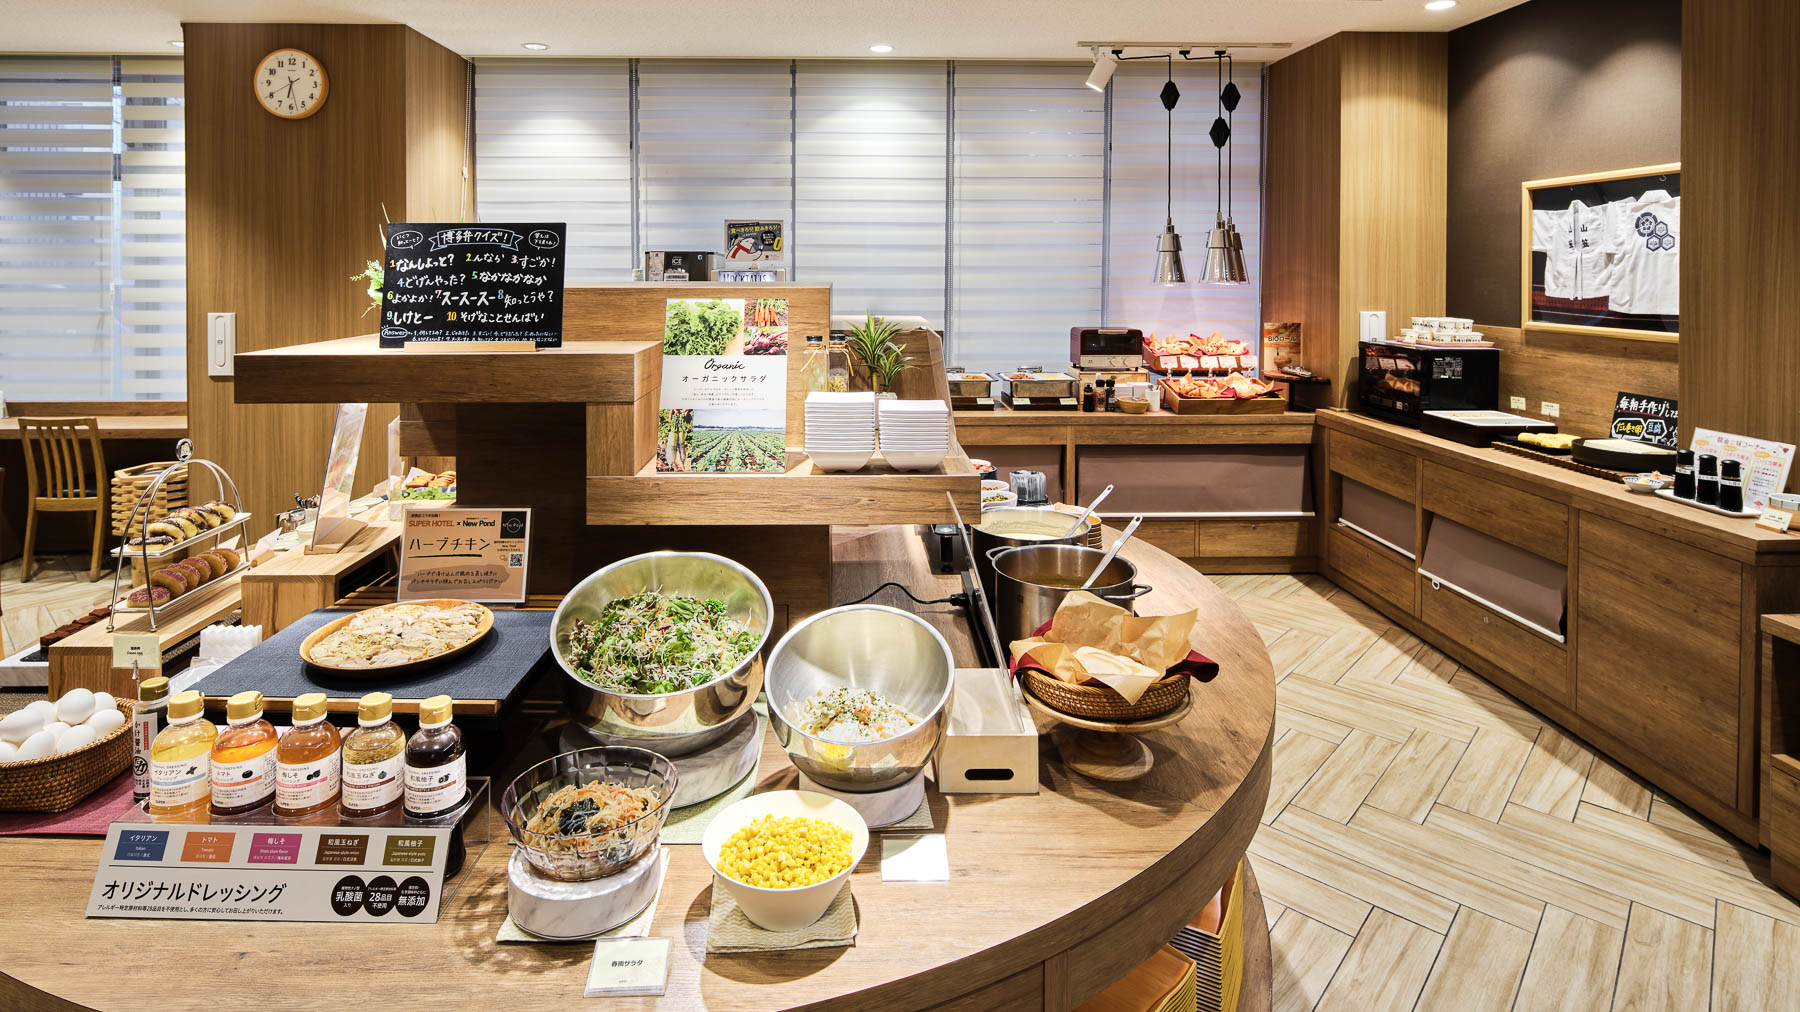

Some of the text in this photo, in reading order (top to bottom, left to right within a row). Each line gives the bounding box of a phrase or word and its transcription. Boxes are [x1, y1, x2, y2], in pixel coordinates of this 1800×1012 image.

[441, 229, 508, 244] 博多弁クイズ!
[704, 358, 745, 371] Organic
[682, 375, 767, 383] オーガニックサラダ
[408, 520, 431, 528] SUPER
[409, 537, 491, 551] ハーブチキン
[130, 834, 158, 842] イタリアン
[267, 837, 286, 845] 梅しそ
[328, 838, 360, 846] 和風玉ねぎ
[398, 839, 423, 847] 和風柚子
[102, 880, 287, 903] オリジナルドレッシング
[335, 891, 363, 902] 乳酸菌
[368, 892, 392, 902] 28品目
[397, 895, 426, 906] 無添加
[611, 959, 643, 967] 春雨サラダ
